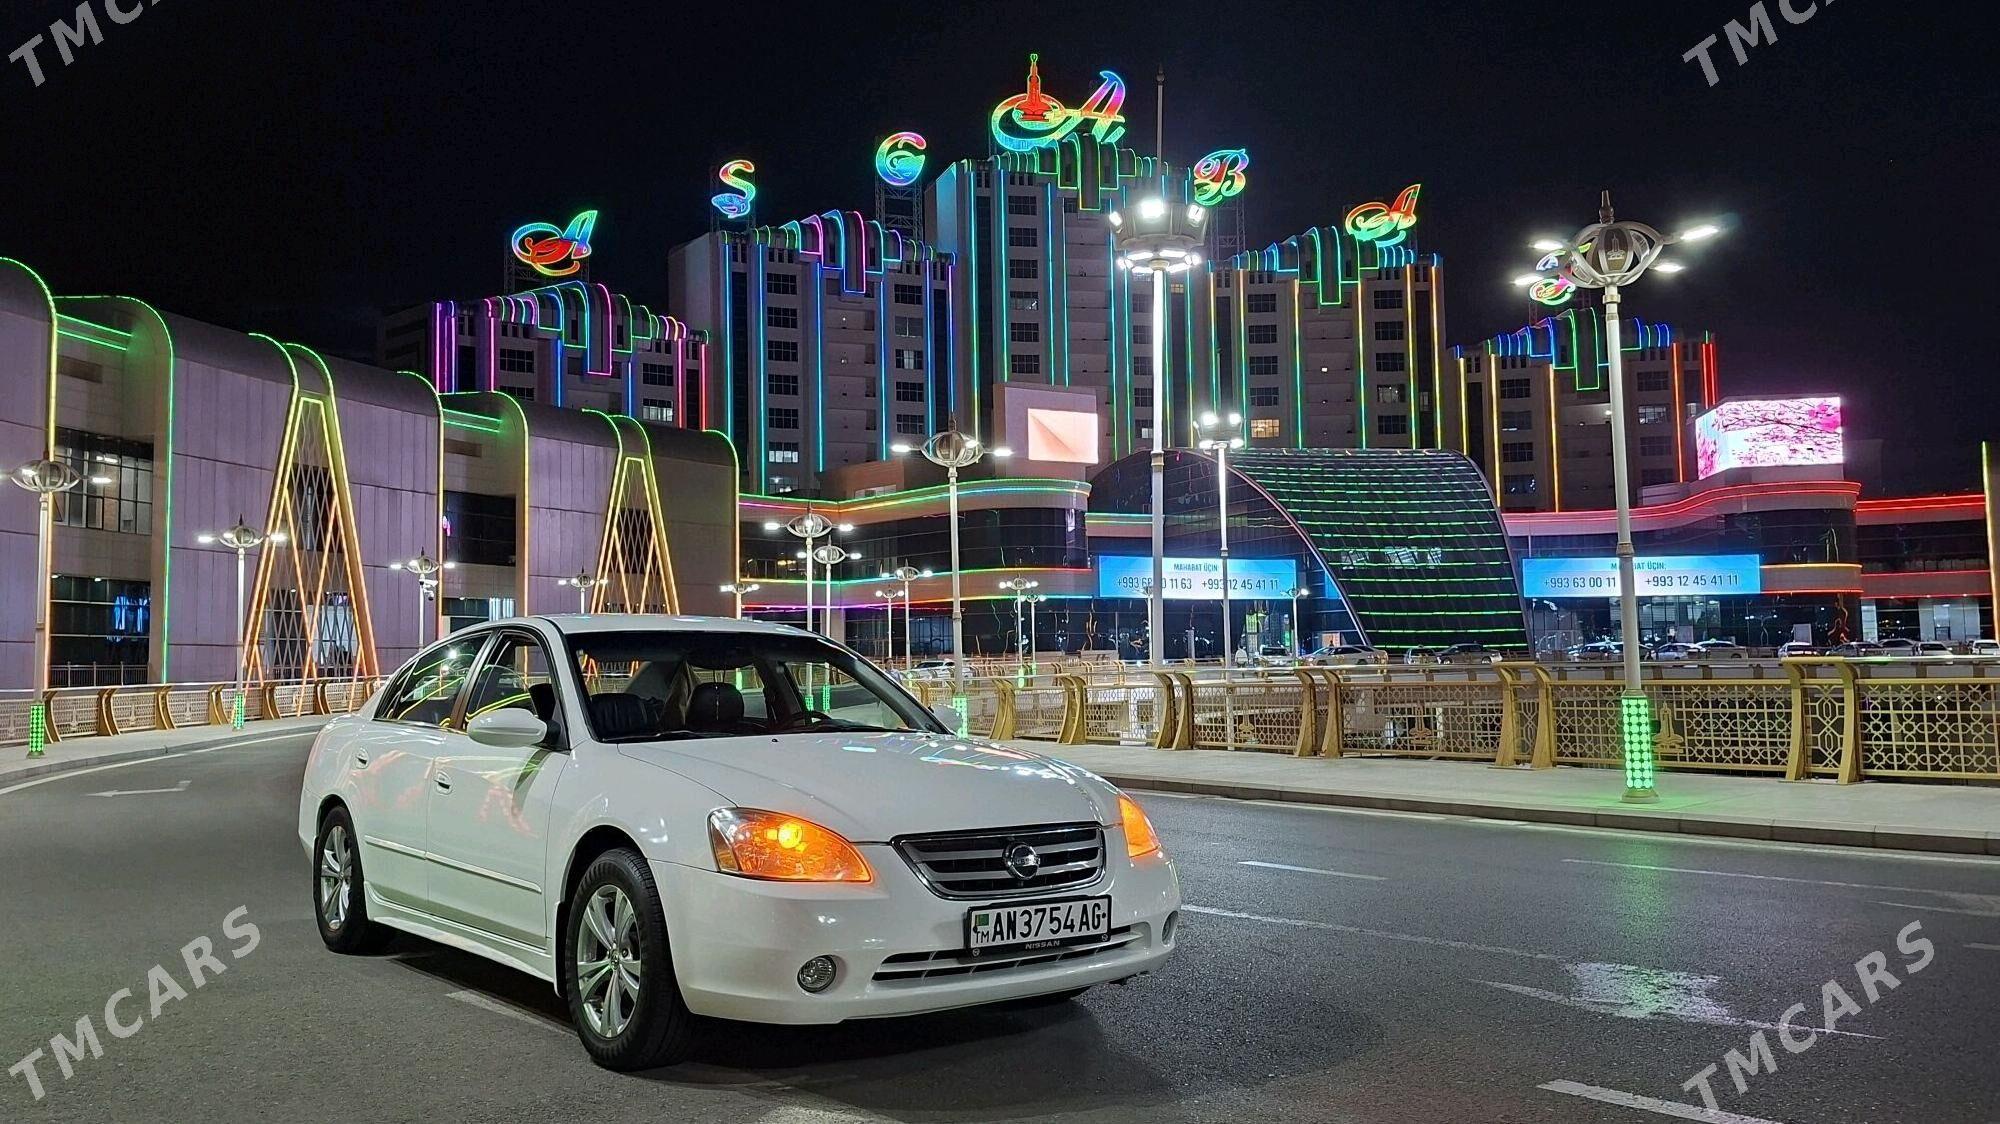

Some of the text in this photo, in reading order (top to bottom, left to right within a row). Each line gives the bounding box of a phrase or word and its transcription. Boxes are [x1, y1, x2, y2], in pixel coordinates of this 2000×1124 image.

[1173, 563, 1202, 572] MAHABAT
[1118, 577, 1139, 588] +993
[1170, 578, 1178, 589] 11
[1181, 578, 1192, 590] 63
[1228, 578, 1238, 590] 12
[1241, 579, 1253, 590] 45
[1256, 579, 1266, 590] 41
[1270, 579, 1278, 590] 11
[1544, 574, 1738, 588] +993 63 00 11 +993 12 45 41 11
[975, 902, 1101, 944] TM AN3754AG
[1025, 940, 1060, 949] NISSAN
